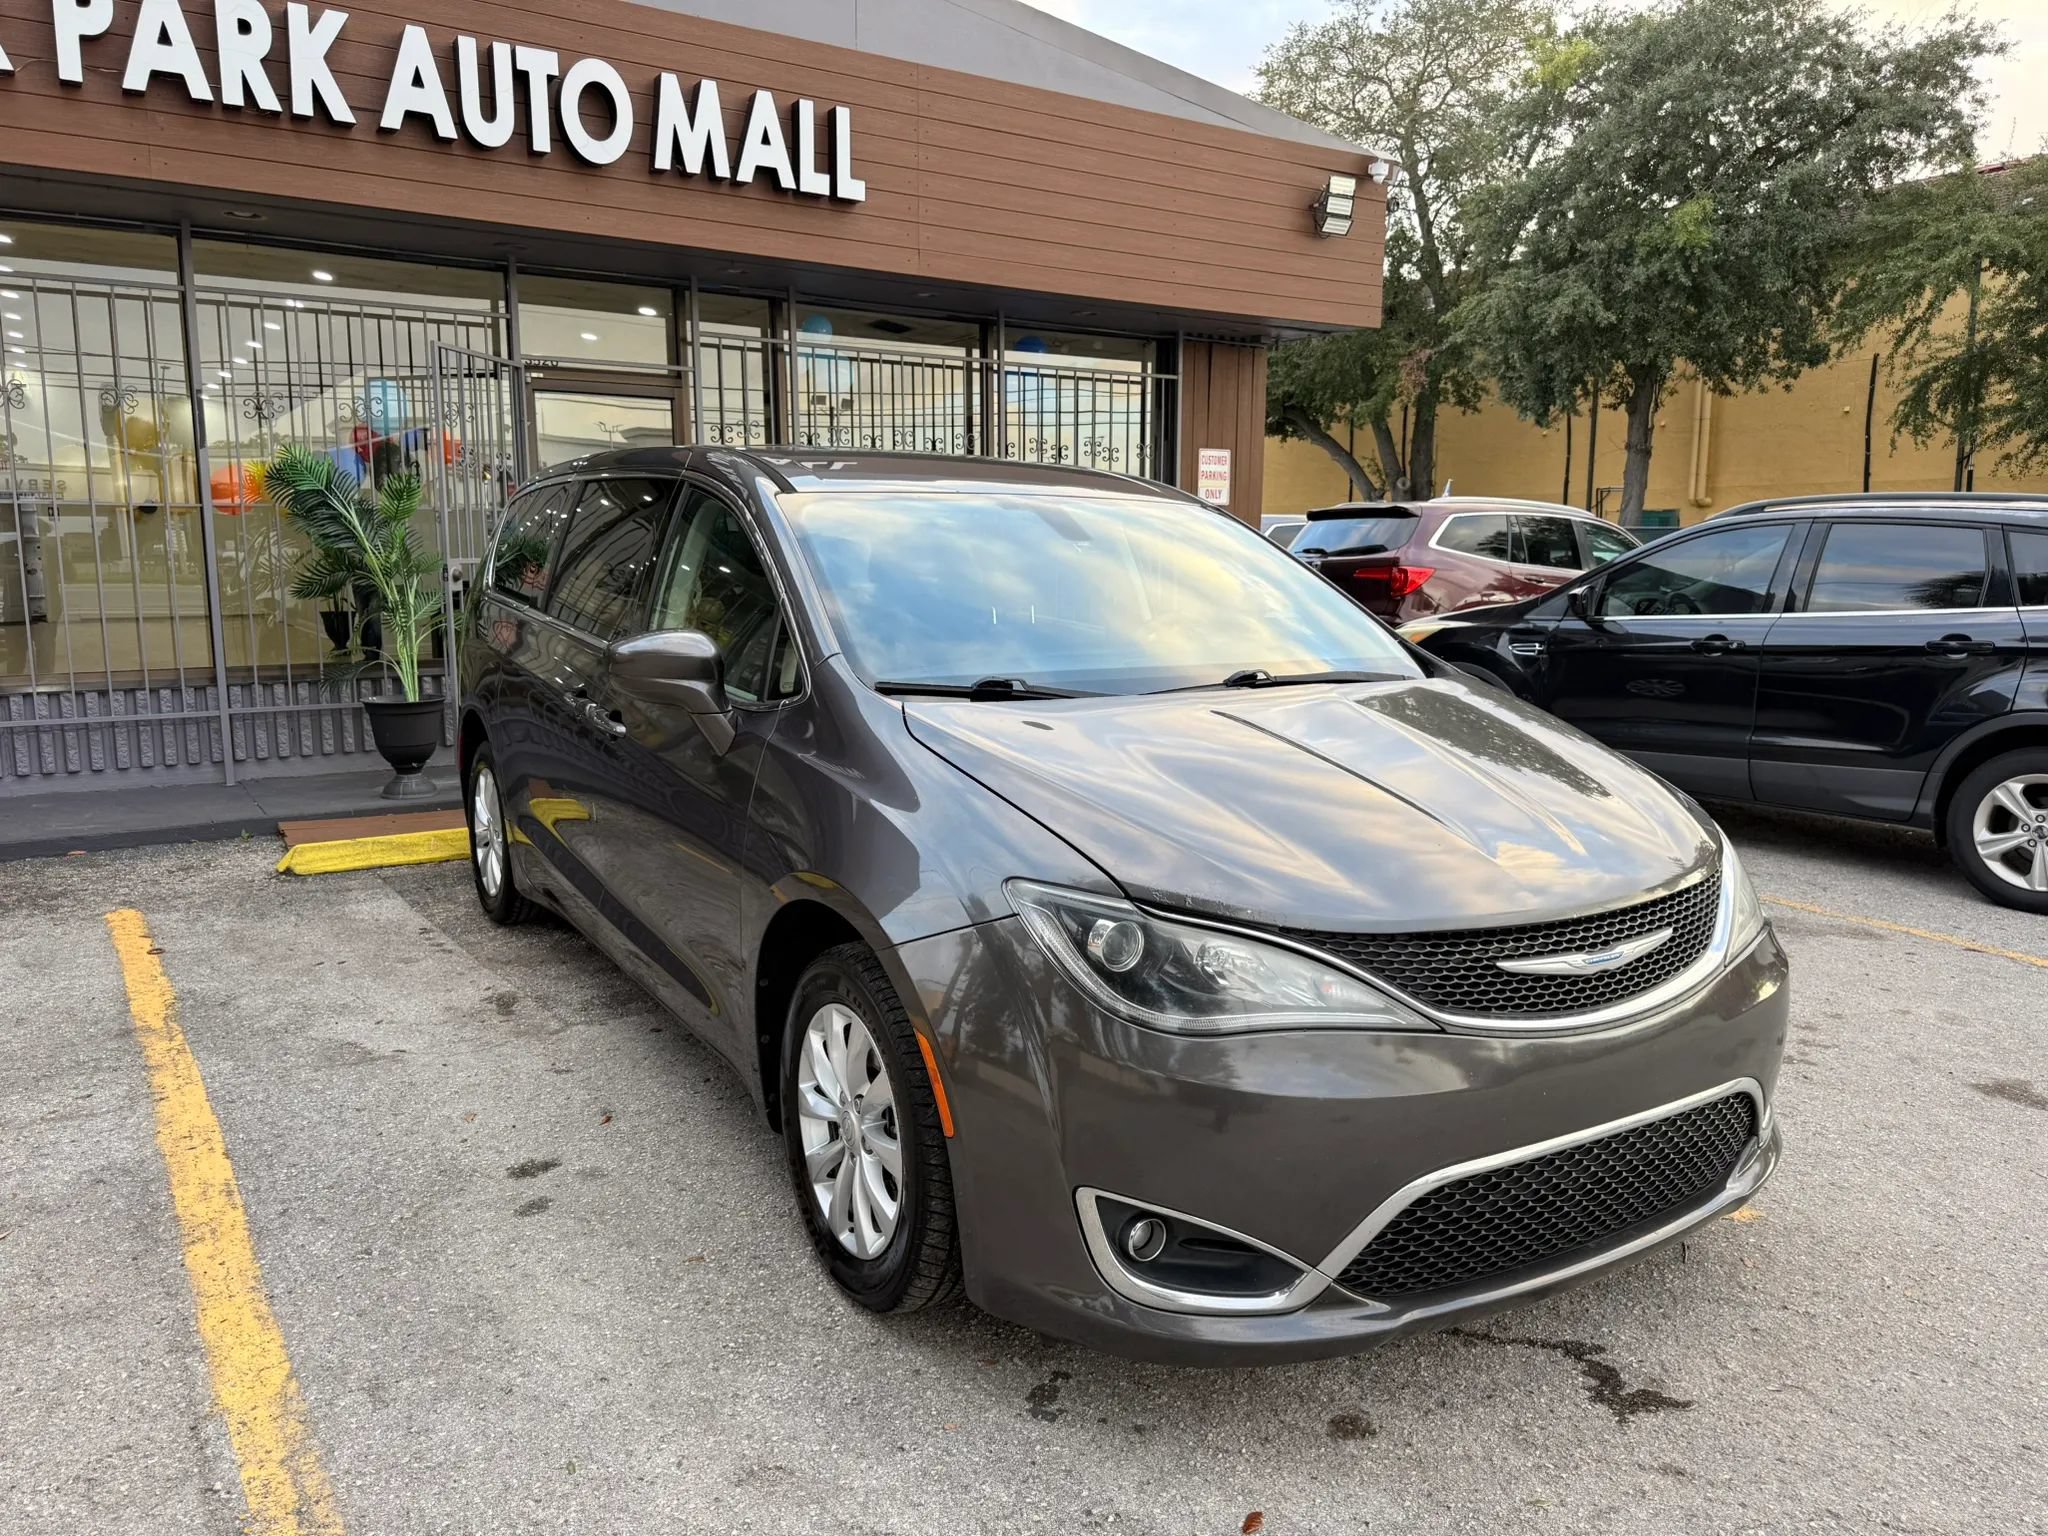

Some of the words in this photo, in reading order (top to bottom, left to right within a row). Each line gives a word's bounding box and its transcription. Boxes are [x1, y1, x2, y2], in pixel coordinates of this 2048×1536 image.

[52, 0, 356, 128] PARK
[379, 24, 634, 165] AUTO
[653, 71, 866, 202] MALL
[1201, 455, 1227, 465] CUSTOMER
[1201, 470, 1227, 480] PARKING
[1205, 489, 1222, 499] ONLY
